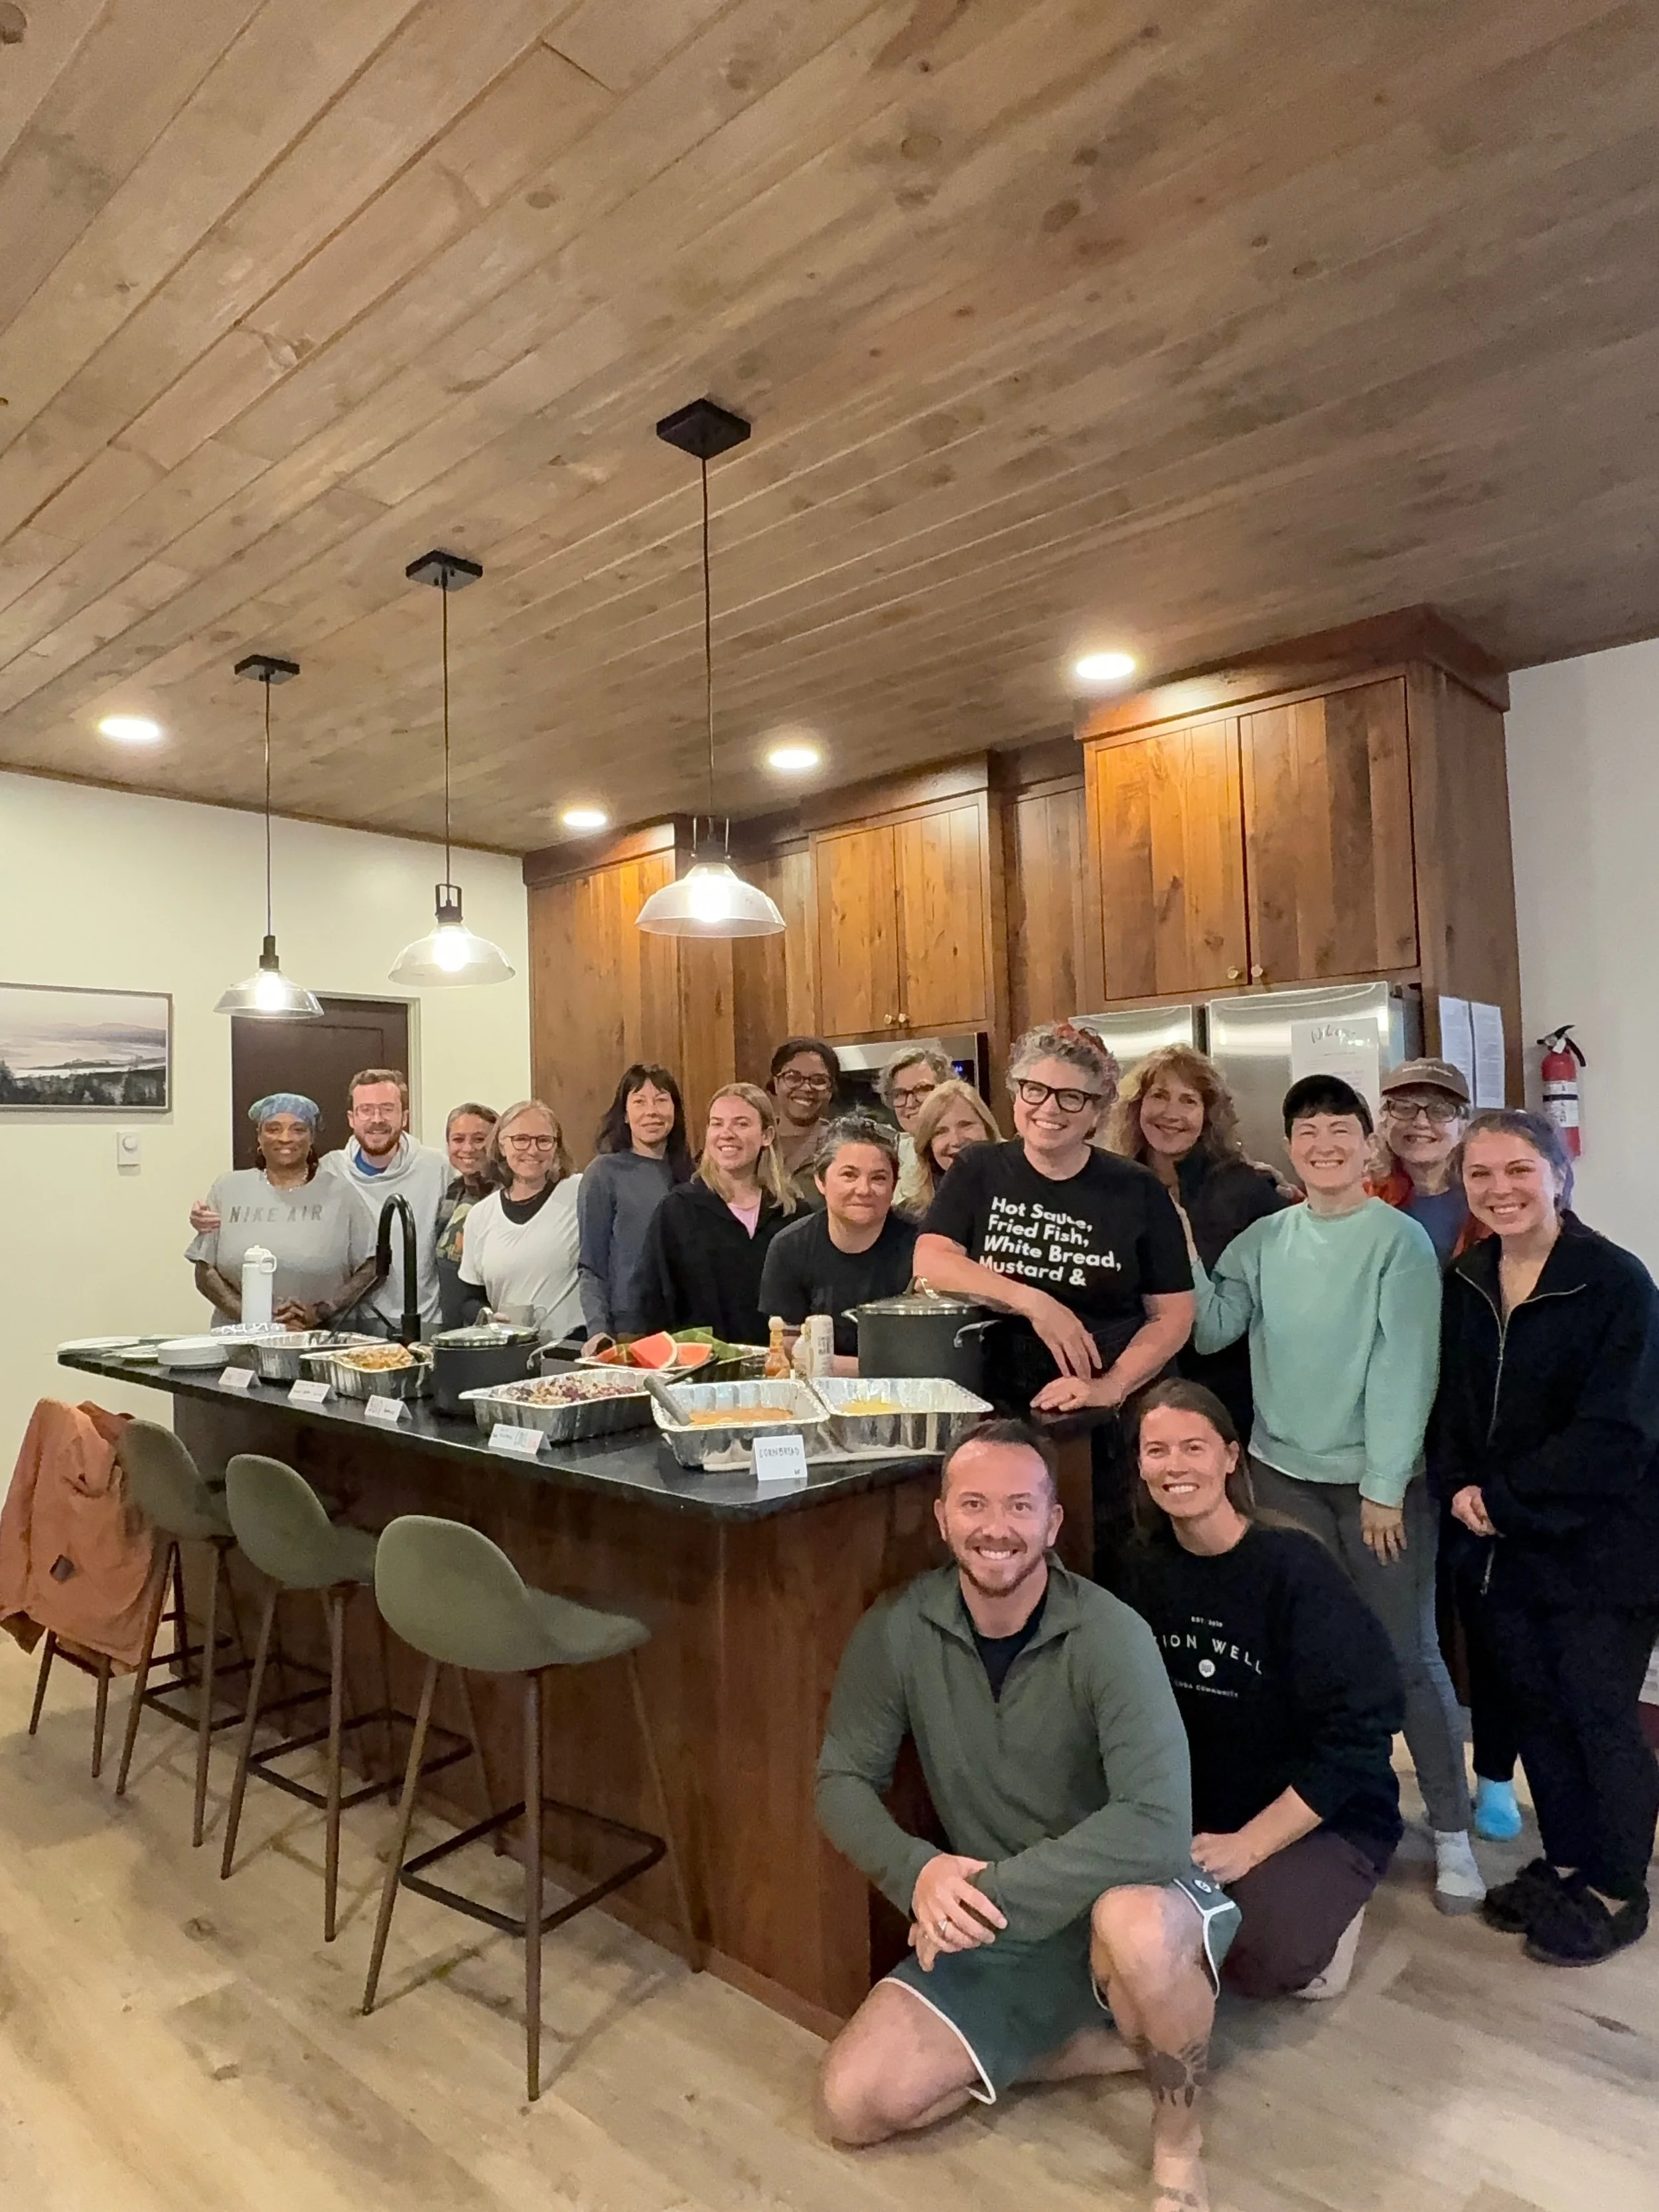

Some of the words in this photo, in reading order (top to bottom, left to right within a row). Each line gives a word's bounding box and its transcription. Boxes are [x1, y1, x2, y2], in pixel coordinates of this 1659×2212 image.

[229, 1205, 279, 1223] NIKE
[287, 1203, 323, 1222] AIR
[991, 1196, 1026, 1217] Hot
[1030, 1203, 1093, 1232] Sauce,
[987, 1214, 1039, 1238] Fried
[1043, 1223, 1089, 1248] Fish,
[978, 1254, 1064, 1282] Mustard
[1069, 1268, 1087, 1286] &
[983, 1234, 1043, 1258] White
[1048, 1244, 1122, 1272] Bread,
[1156, 1634, 1198, 1649] ION
[1211, 1638, 1262, 1675] WELL
